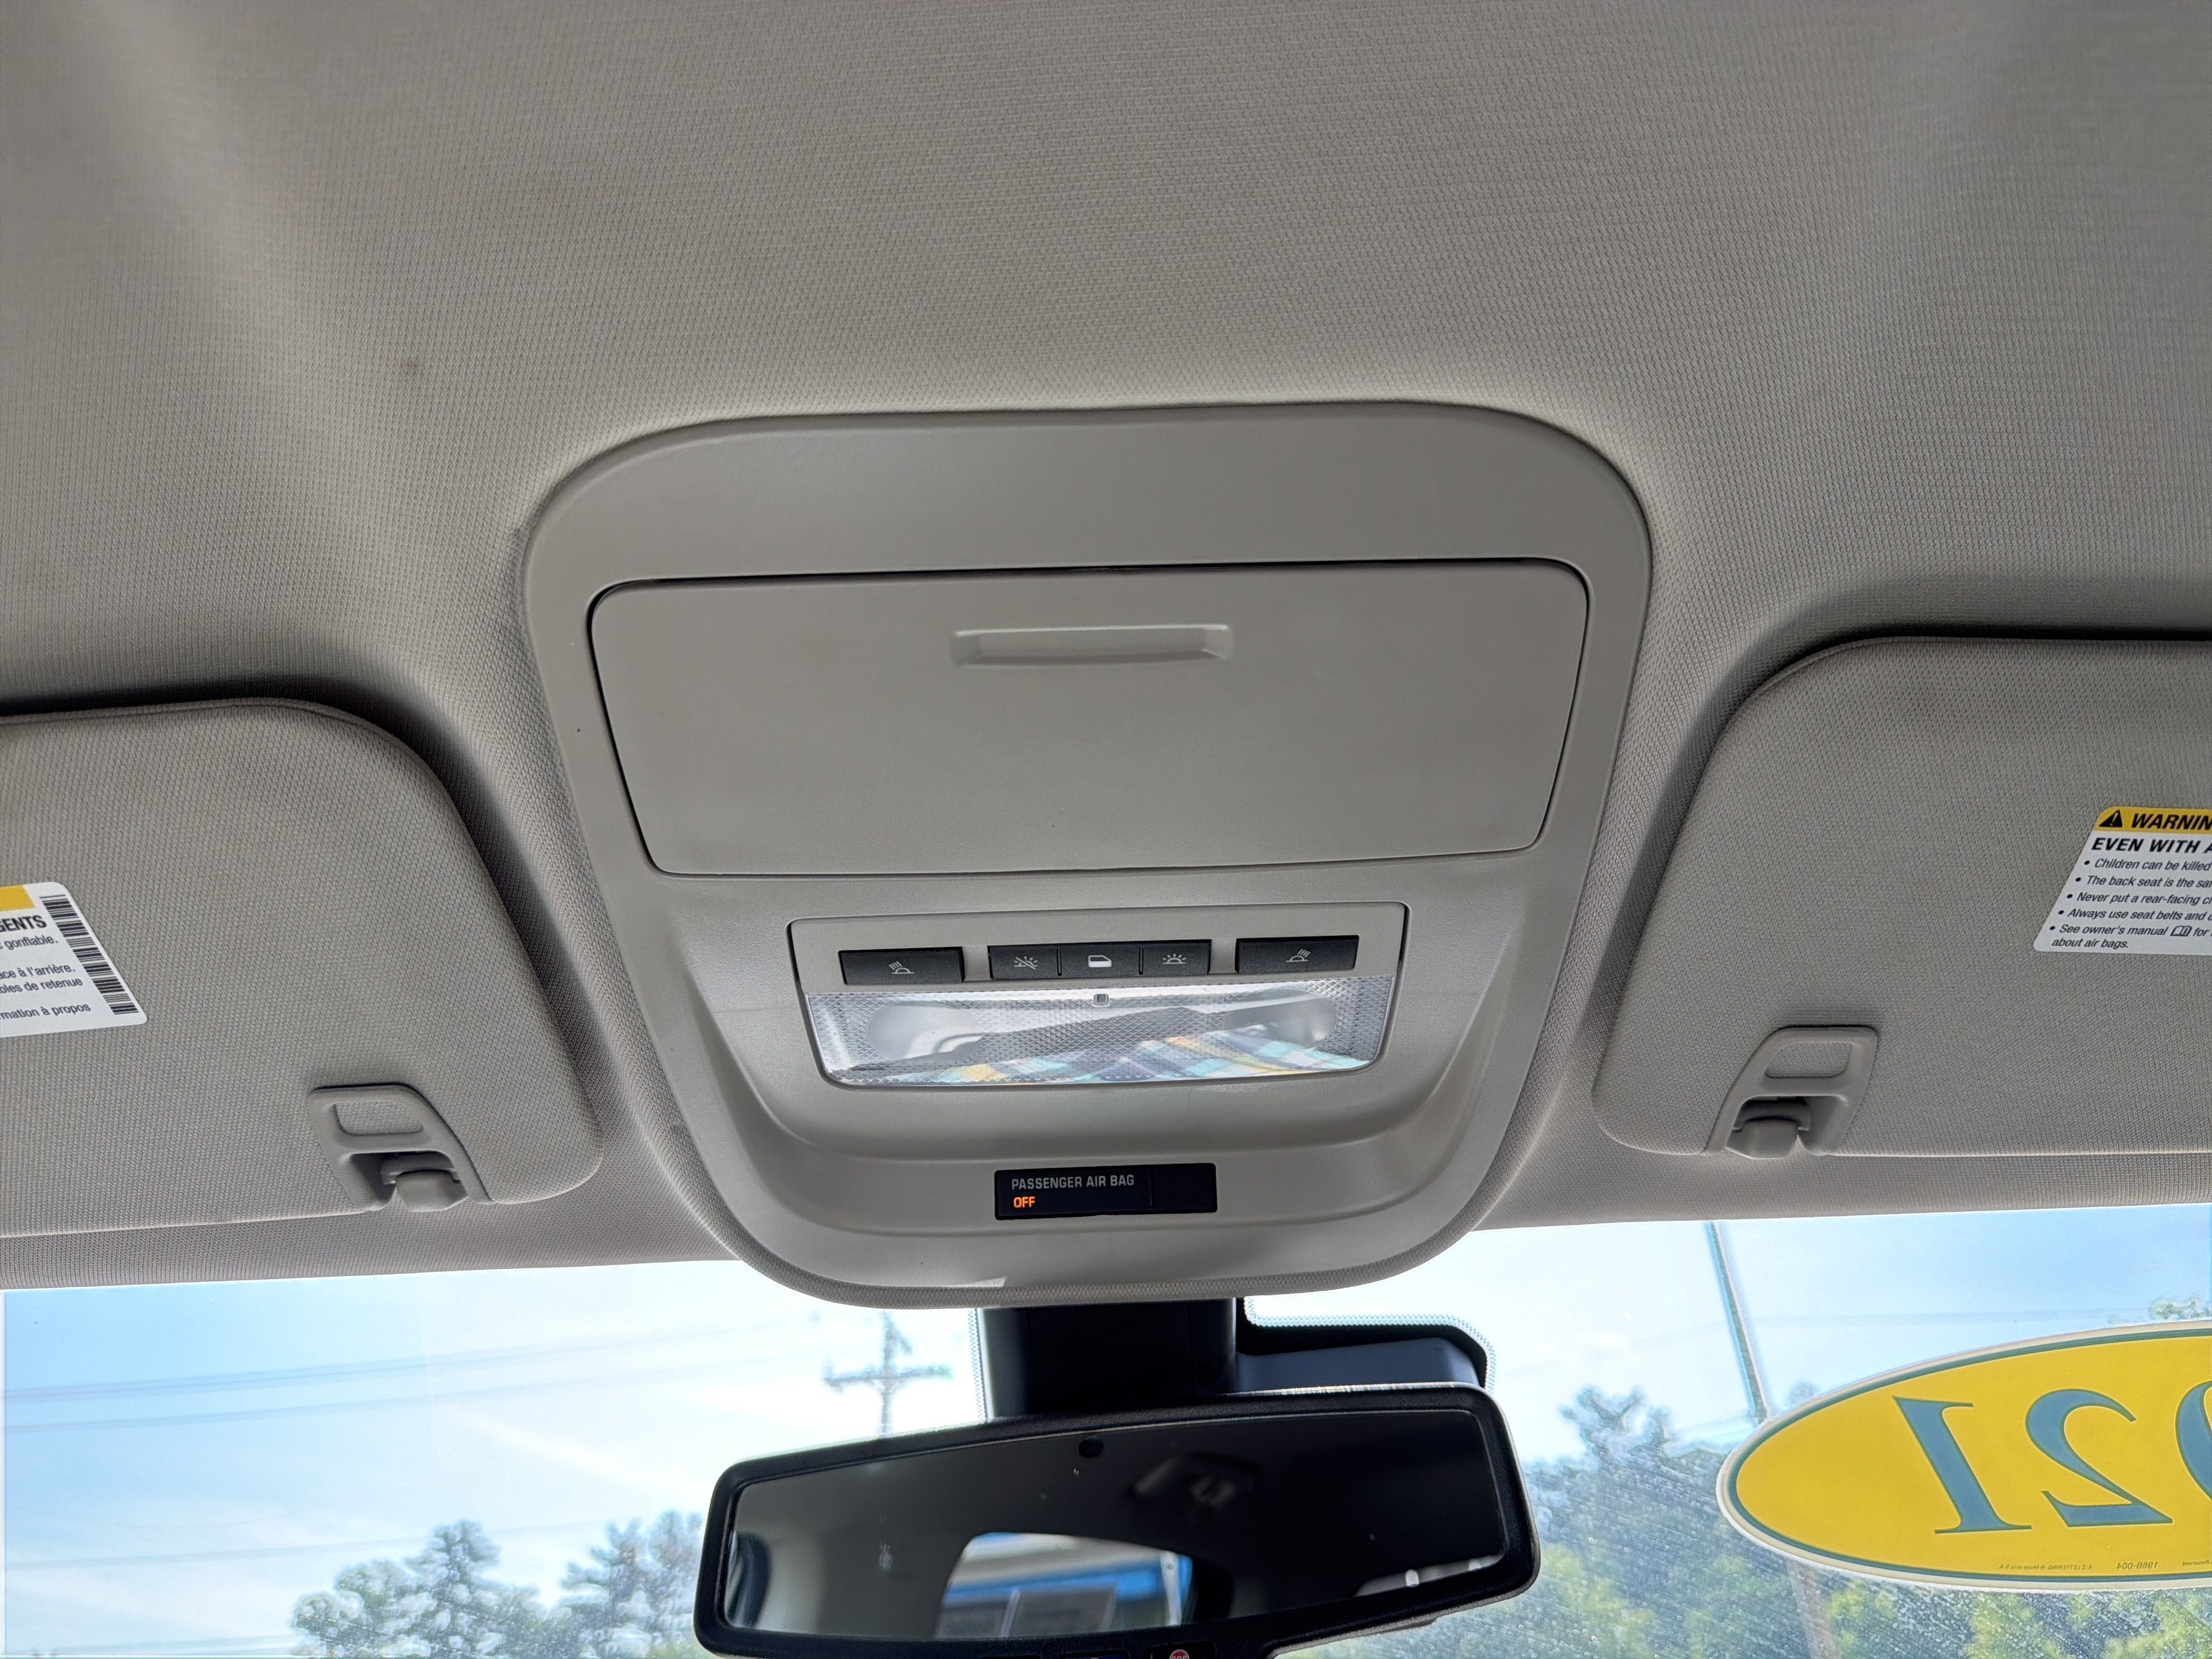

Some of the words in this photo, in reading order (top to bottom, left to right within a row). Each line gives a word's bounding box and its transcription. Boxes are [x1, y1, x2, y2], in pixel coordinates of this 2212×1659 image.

[2091, 837, 2143, 851] EVEN
[2149, 839, 2201, 854] WITH
[2095, 859, 2140, 869] Children
[2142, 861, 2163, 870] can
[2164, 860, 2180, 871] be
[2181, 860, 2212, 871] killed
[2087, 876, 2107, 885] The
[2108, 876, 2136, 887] back
[2137, 878, 2163, 887] seat
[2163, 878, 2174, 887] is
[2176, 878, 2194, 888] the
[2076, 892, 2110, 901] Never
[2109, 894, 2130, 904] put
[2140, 894, 2201, 906] rear-facing
[2067, 909, 2107, 919] Always
[2130, 910, 2155, 919] seat
[2155, 910, 2183, 920] belts
[2184, 911, 2208, 921] and
[2059, 924, 2080, 933] See
[2082, 926, 2125, 935] owner's
[2126, 927, 2169, 935] manual
[2193, 928, 2210, 937] for
[4, 935, 58, 950] gonflable.
[2051, 938, 2083, 947] about
[2084, 939, 2100, 947] air
[2101, 939, 2128, 950] bags.
[17, 967, 27, 977] à
[26, 964, 76, 976] l'arrière.
[24, 981, 39, 991] de
[40, 978, 83, 990] retenue
[40, 1006, 51, 1015] à
[51, 1004, 91, 1016] propos
[1012, 1176, 1082, 1190] PASSENGER
[1086, 1175, 1106, 1187] AIR
[1110, 1174, 1135, 1187] BAG
[1013, 1196, 1036, 1208] OFF
